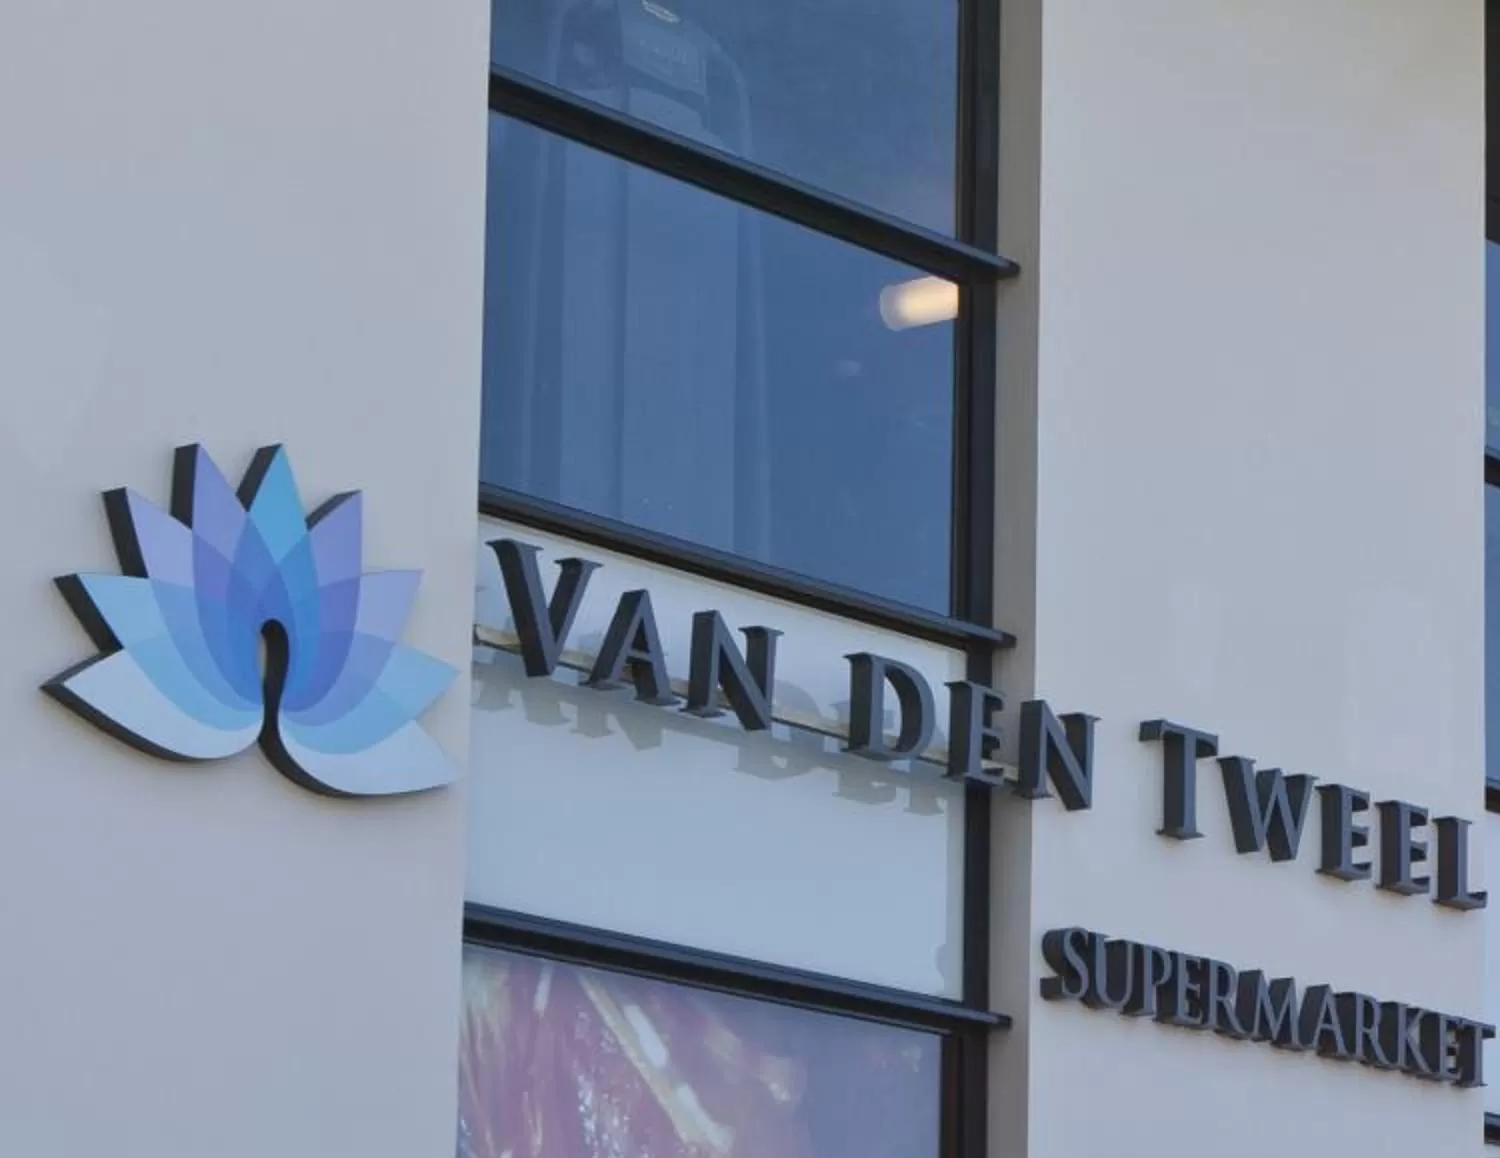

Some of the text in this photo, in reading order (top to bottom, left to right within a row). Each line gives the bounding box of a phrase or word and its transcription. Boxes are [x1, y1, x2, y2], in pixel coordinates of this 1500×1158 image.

[485, 538, 1488, 910] VAN DEN TWEEL
[1040, 926, 1497, 1087] SUPERMARKET
